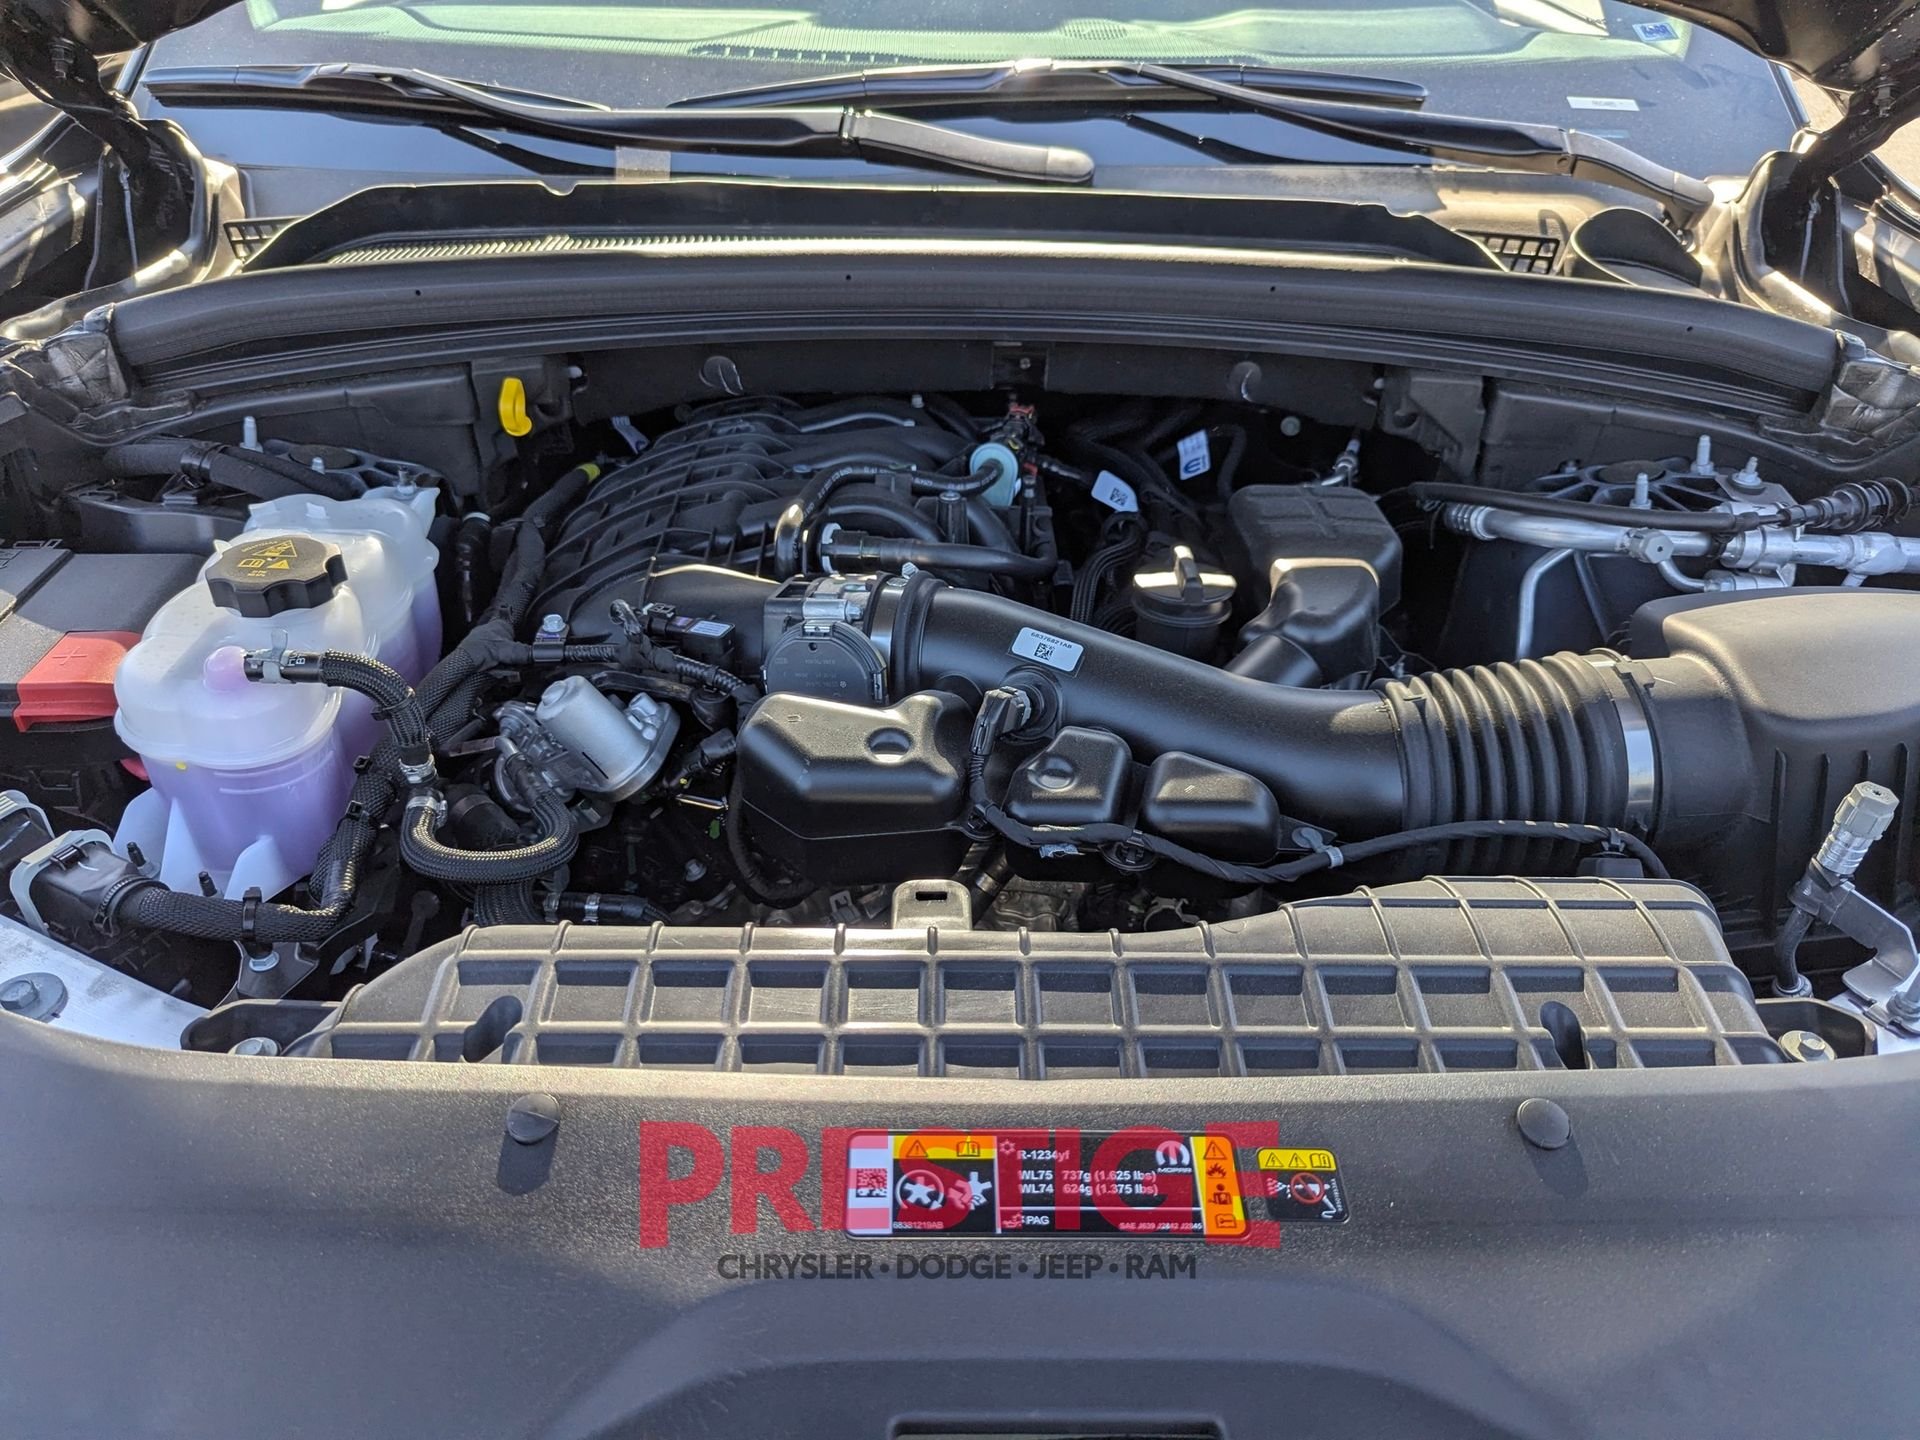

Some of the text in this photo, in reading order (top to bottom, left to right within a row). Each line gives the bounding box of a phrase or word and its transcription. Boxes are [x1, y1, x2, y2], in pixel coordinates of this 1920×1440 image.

[1017, 1149, 1071, 1162] R-1234yf
[1019, 1169, 1157, 1183] WL75 737g (1.625 lbs)
[1019, 1183, 1159, 1196] WL74 624g (1.375 lbs)
[1026, 1216, 1050, 1225] PAG
